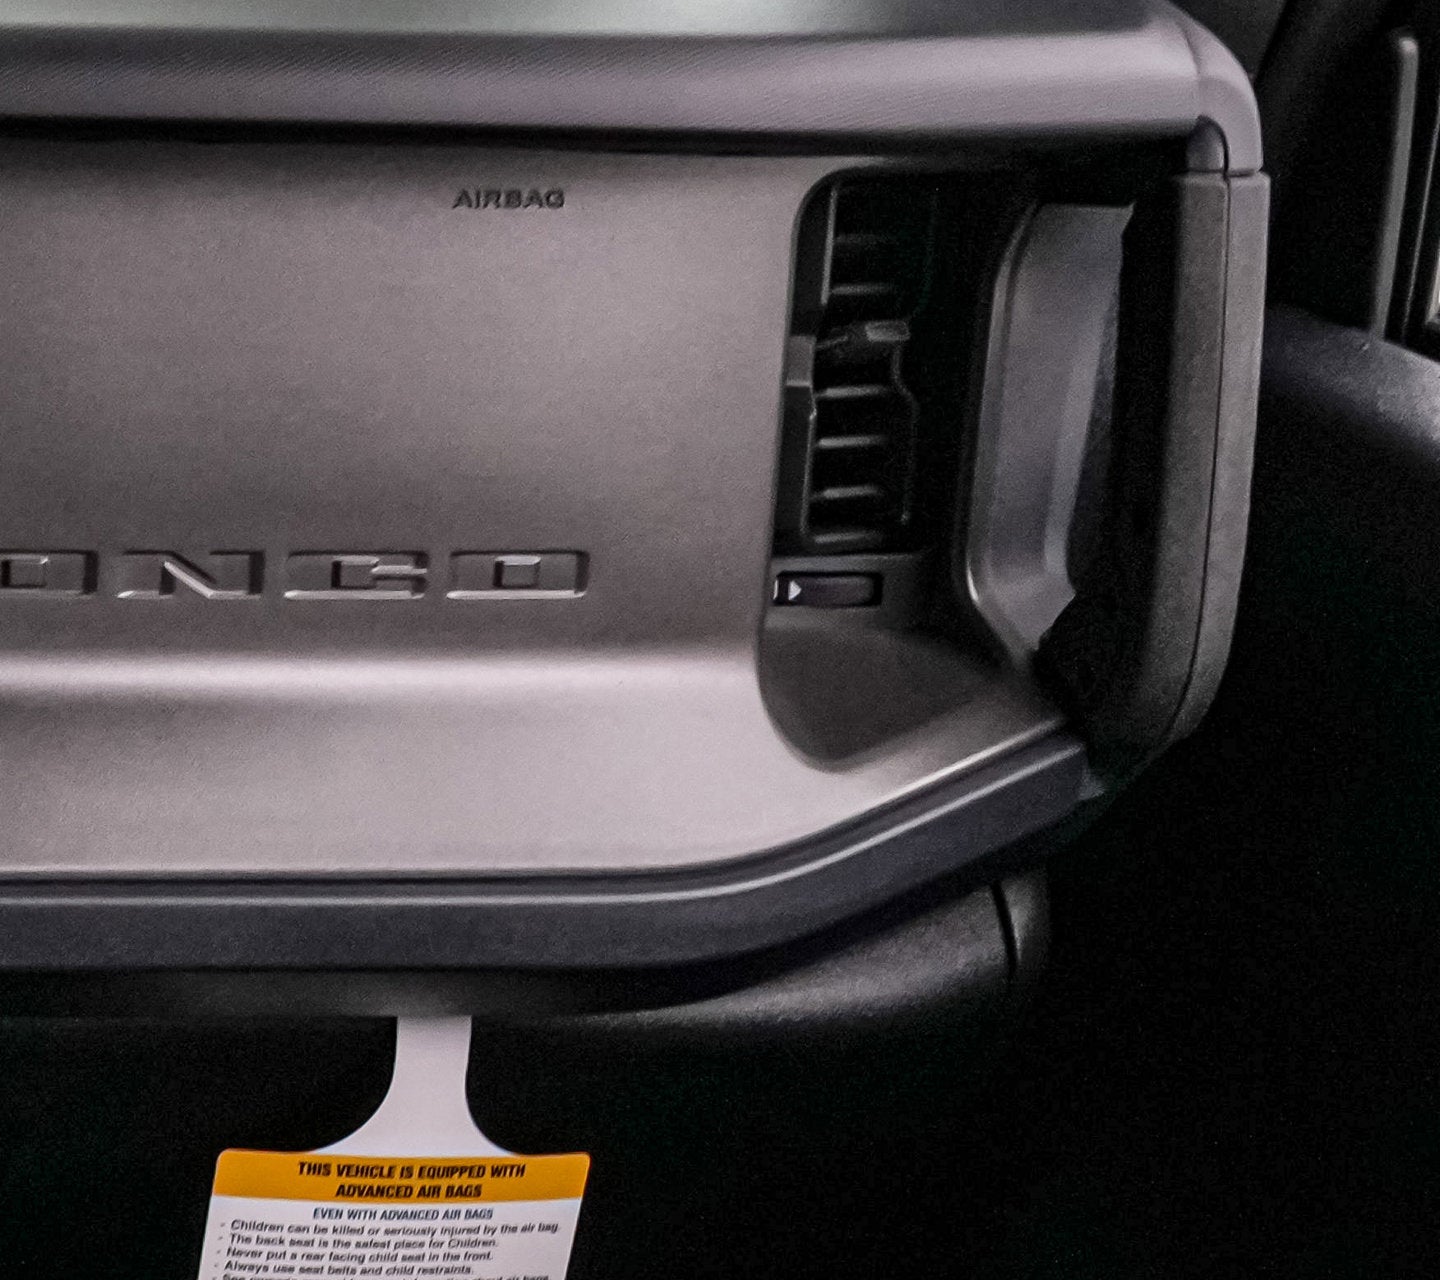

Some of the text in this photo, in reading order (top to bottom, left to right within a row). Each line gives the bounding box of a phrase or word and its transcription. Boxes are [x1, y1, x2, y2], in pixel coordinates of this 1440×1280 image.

[451, 189, 566, 209] AIRBAG
[299, 1162, 526, 1179] THIS VEHICLE IS EQUIPPED WITH
[336, 1184, 482, 1198] ADVANCED AIR BAGS
[312, 1207, 493, 1220] EVEN WITH ADVANCED AIR BAGS
[231, 1220, 284, 1233] Children
[287, 1225, 310, 1233] can
[314, 1225, 328, 1234] be
[332, 1226, 364, 1235] killed
[384, 1226, 437, 1238] seriously
[440, 1225, 482, 1237] injured
[484, 1225, 497, 1236] by
[501, 1224, 517, 1233] the
[521, 1224, 535, 1232] air
[230, 1233, 252, 1245] The
[255, 1235, 284, 1245] back
[289, 1238, 315, 1247] seat
[318, 1239, 329, 1247] is
[333, 1239, 351, 1248] the
[355, 1240, 391, 1249] safest
[394, 1240, 425, 1252] place
[429, 1240, 444, 1249] for
[227, 1248, 263, 1258] Never
[266, 1250, 287, 1261] put
[301, 1253, 324, 1261] rear
[329, 1252, 365, 1265] facing
[369, 1252, 398, 1262] child
[401, 1252, 425, 1261] seat
[429, 1252, 439, 1261] in
[443, 1252, 461, 1261] the
[225, 1261, 269, 1274] Always
[299, 1265, 323, 1274] seat
[328, 1265, 357, 1274] belts
[360, 1265, 381, 1275] and
[386, 1264, 414, 1275] child
